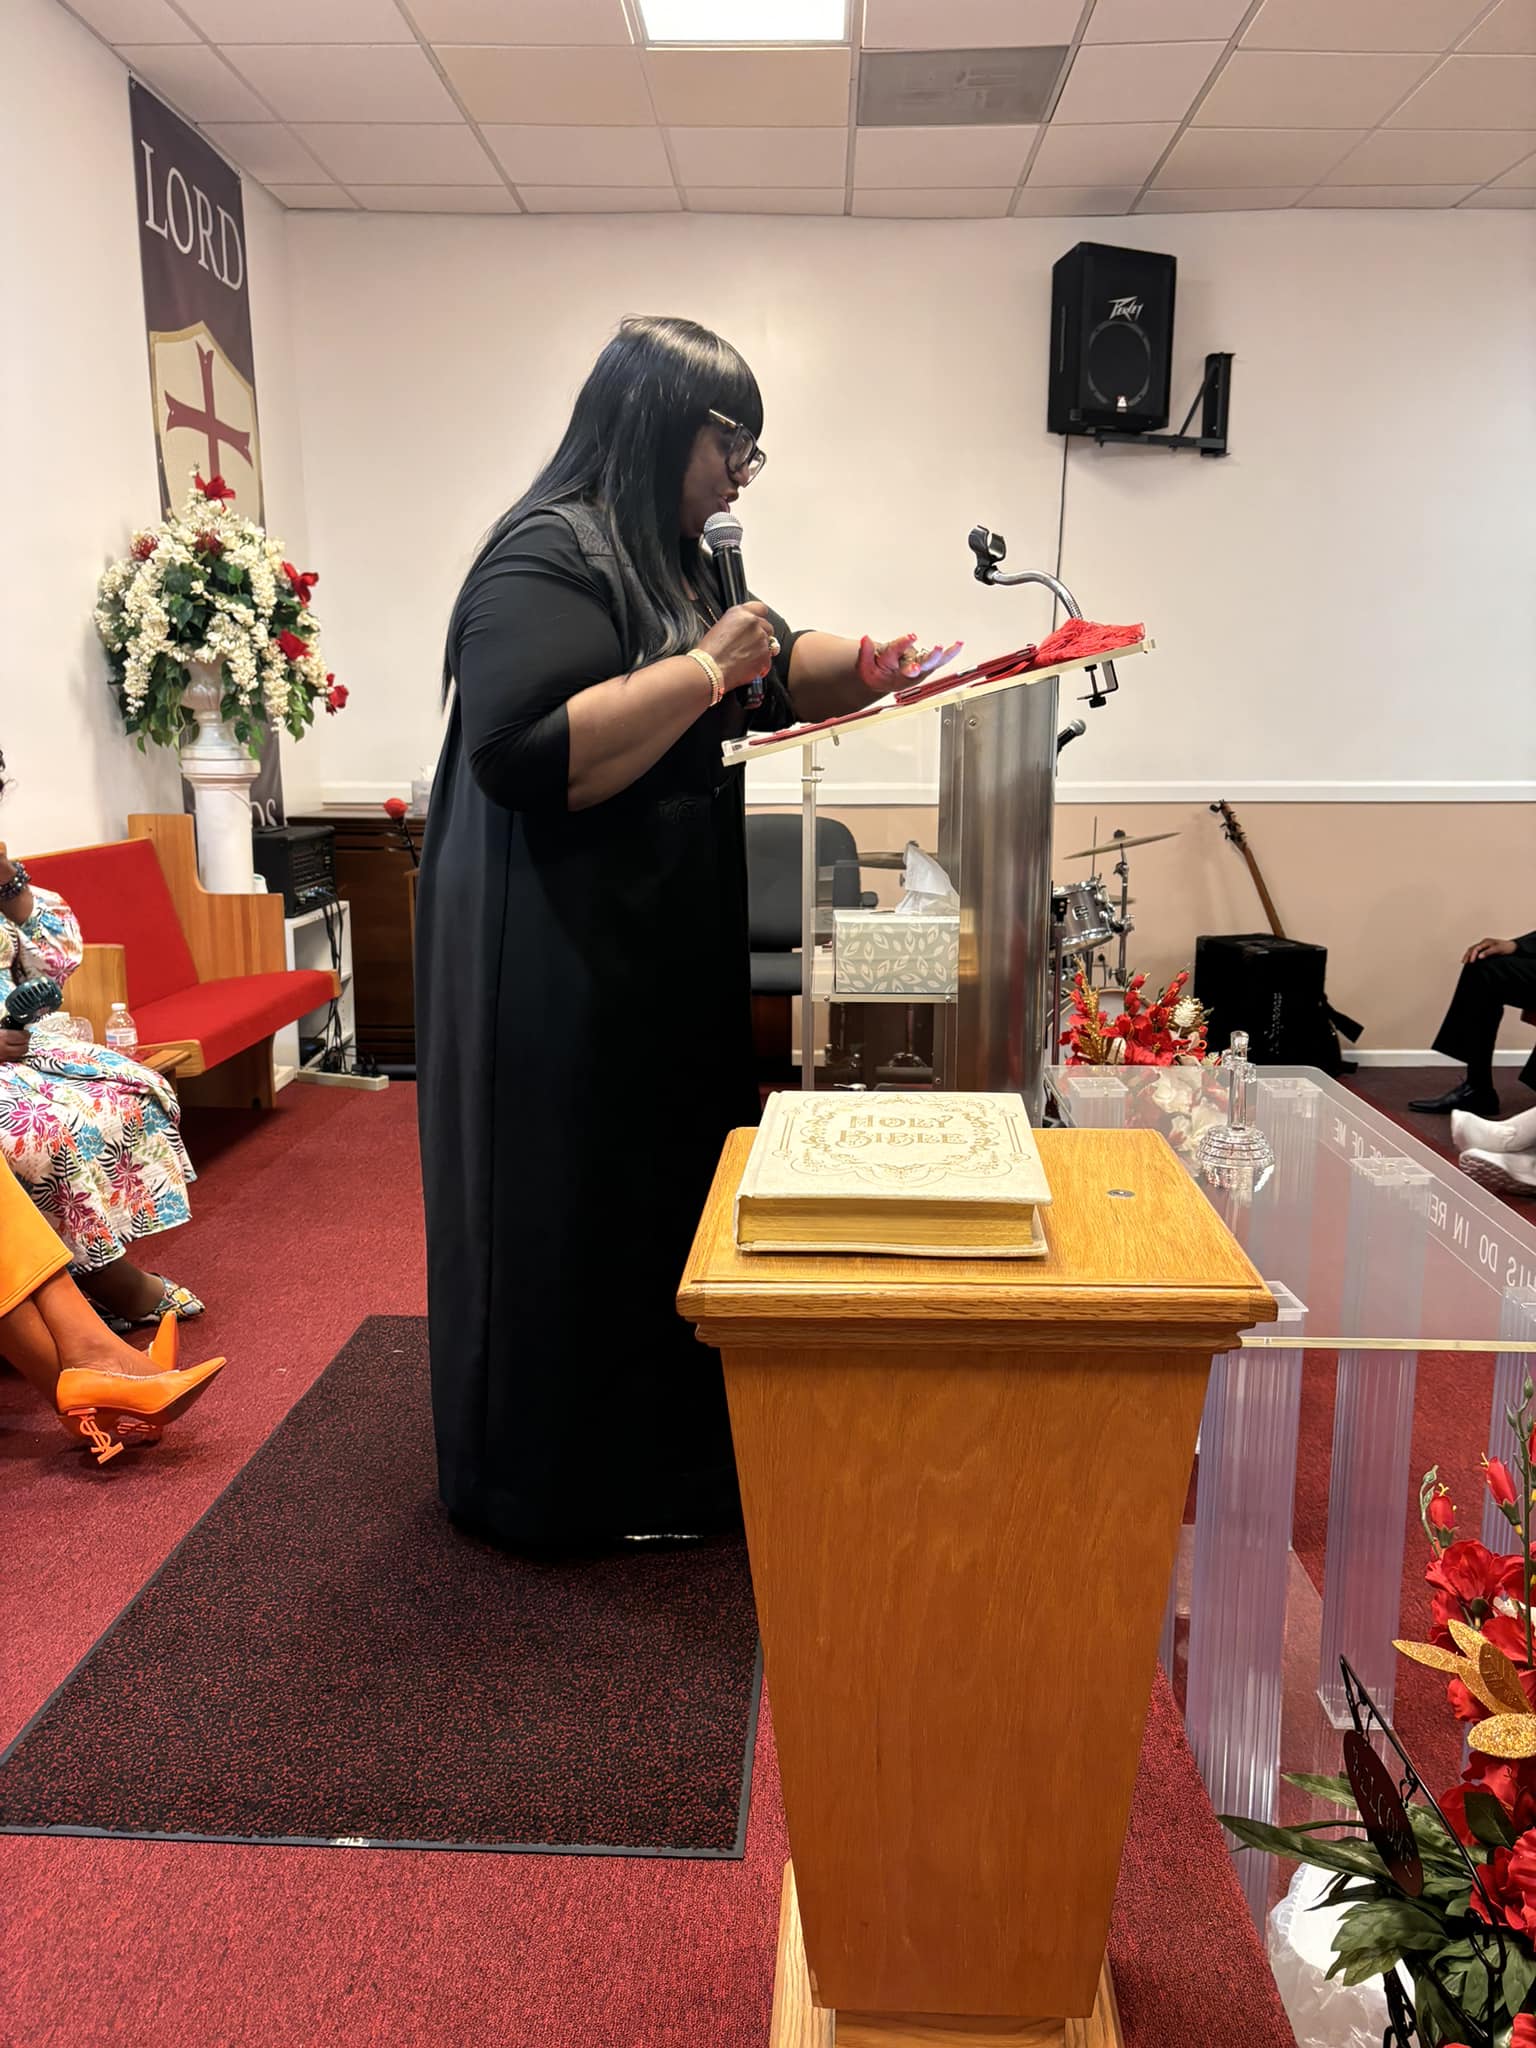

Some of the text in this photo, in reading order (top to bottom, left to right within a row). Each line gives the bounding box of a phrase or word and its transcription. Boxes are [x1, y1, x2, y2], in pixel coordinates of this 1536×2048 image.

[141, 139, 243, 291] LORD
[850, 1115, 954, 1128] HOLY
[835, 1130, 968, 1148] BIBLE
